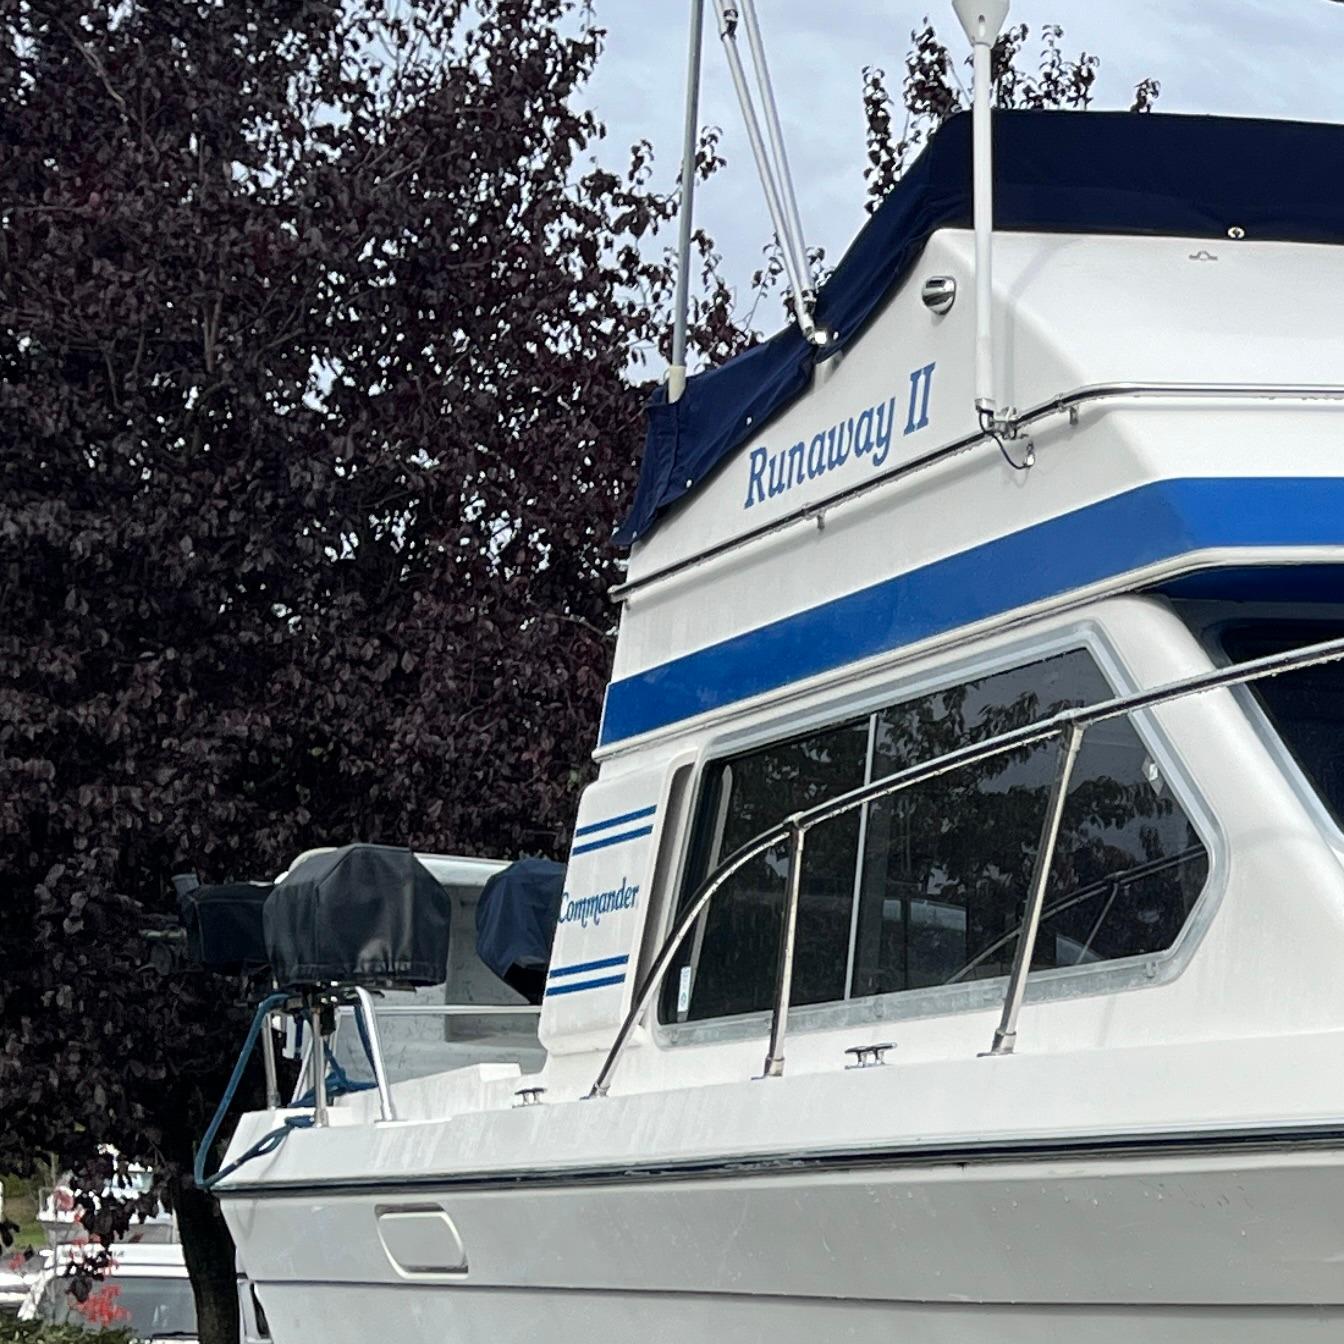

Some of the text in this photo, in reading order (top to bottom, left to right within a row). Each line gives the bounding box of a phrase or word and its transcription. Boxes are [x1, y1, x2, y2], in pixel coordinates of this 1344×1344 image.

[744, 361, 936, 509] Runaway II
[558, 876, 640, 928] Commander
